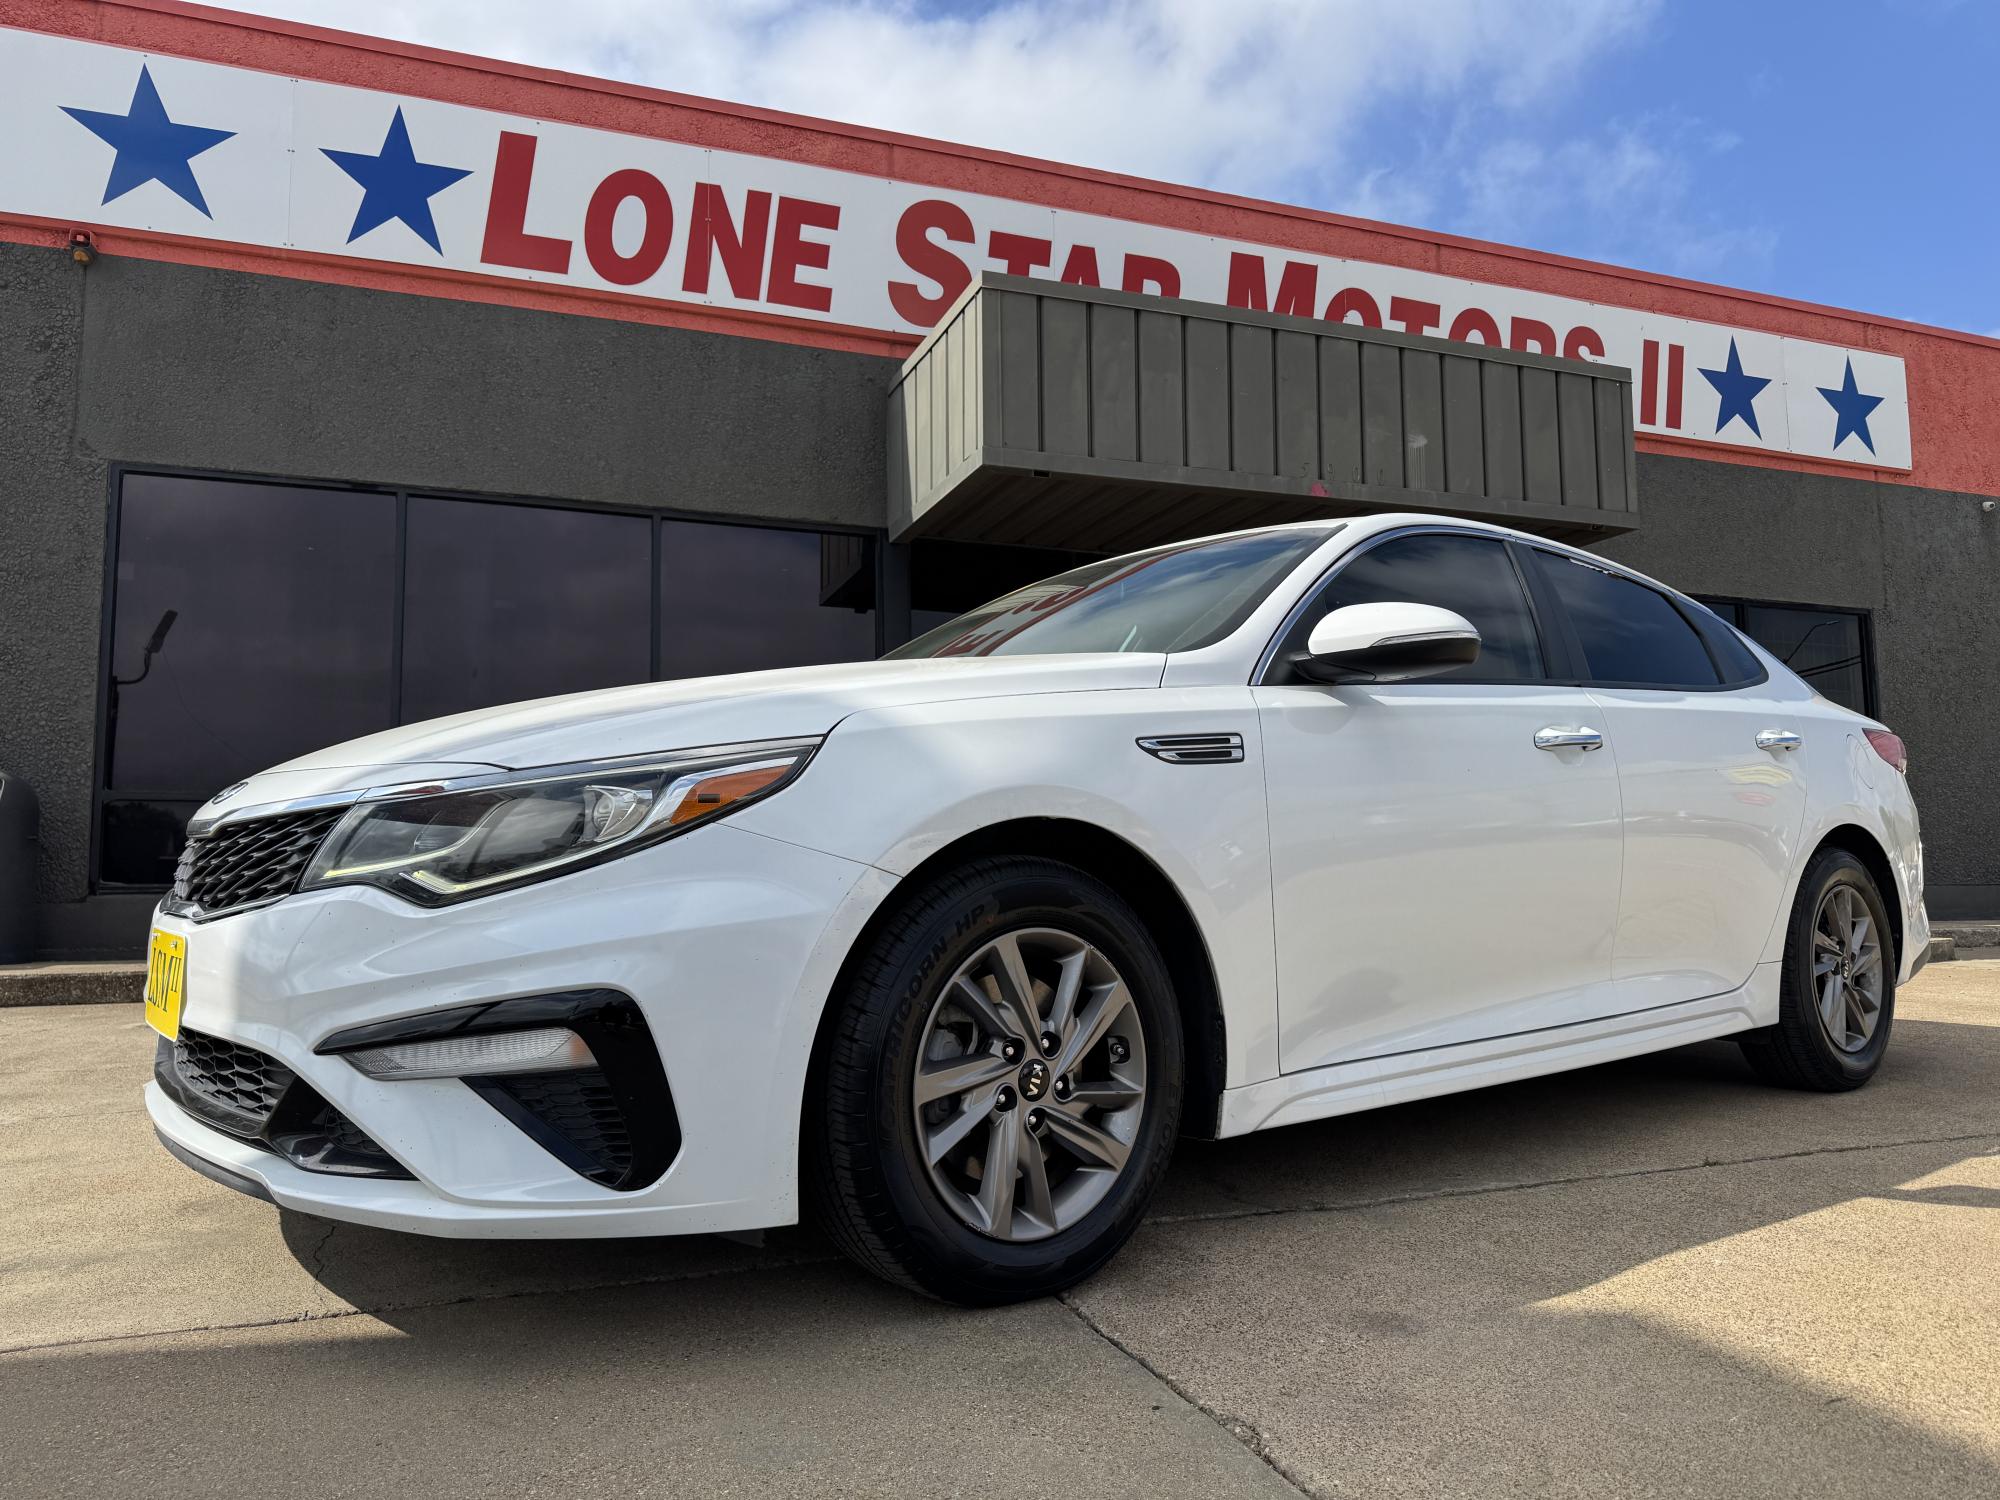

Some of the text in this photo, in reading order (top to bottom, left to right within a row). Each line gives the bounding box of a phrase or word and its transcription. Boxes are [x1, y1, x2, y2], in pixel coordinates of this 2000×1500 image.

[480, 130, 841, 313] LONE
[1639, 339, 1685, 430] II
[955, 904, 986, 937] HP
[1027, 1063, 1043, 1096] KIA
